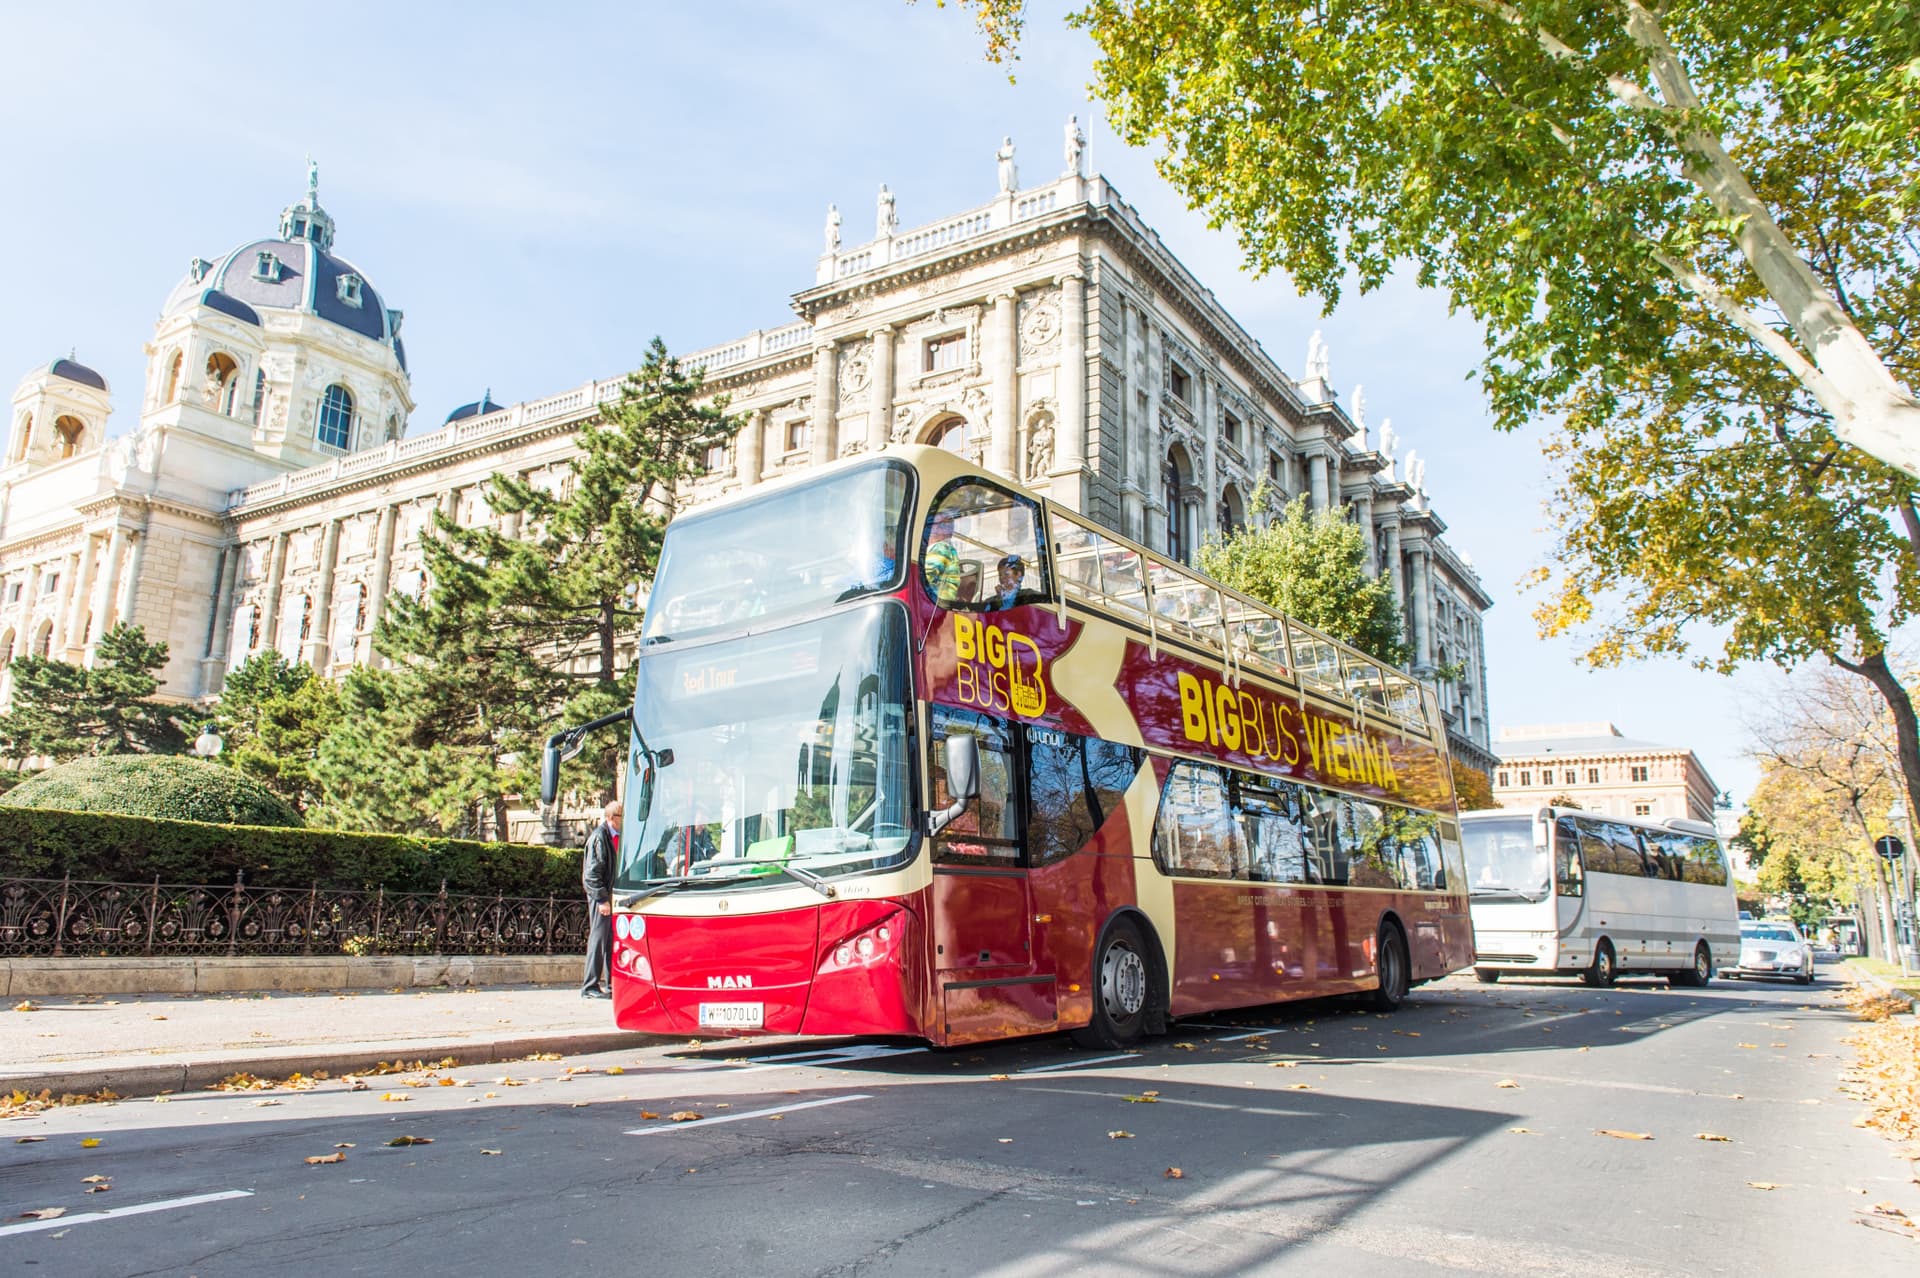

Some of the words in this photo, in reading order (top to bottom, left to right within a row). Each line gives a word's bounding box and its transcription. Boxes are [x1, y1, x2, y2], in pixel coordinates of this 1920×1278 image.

[954, 613, 1006, 669] BIG
[957, 662, 1010, 711] BUS
[1302, 710, 1399, 792] VIENNA
[707, 975, 753, 989] MAN
